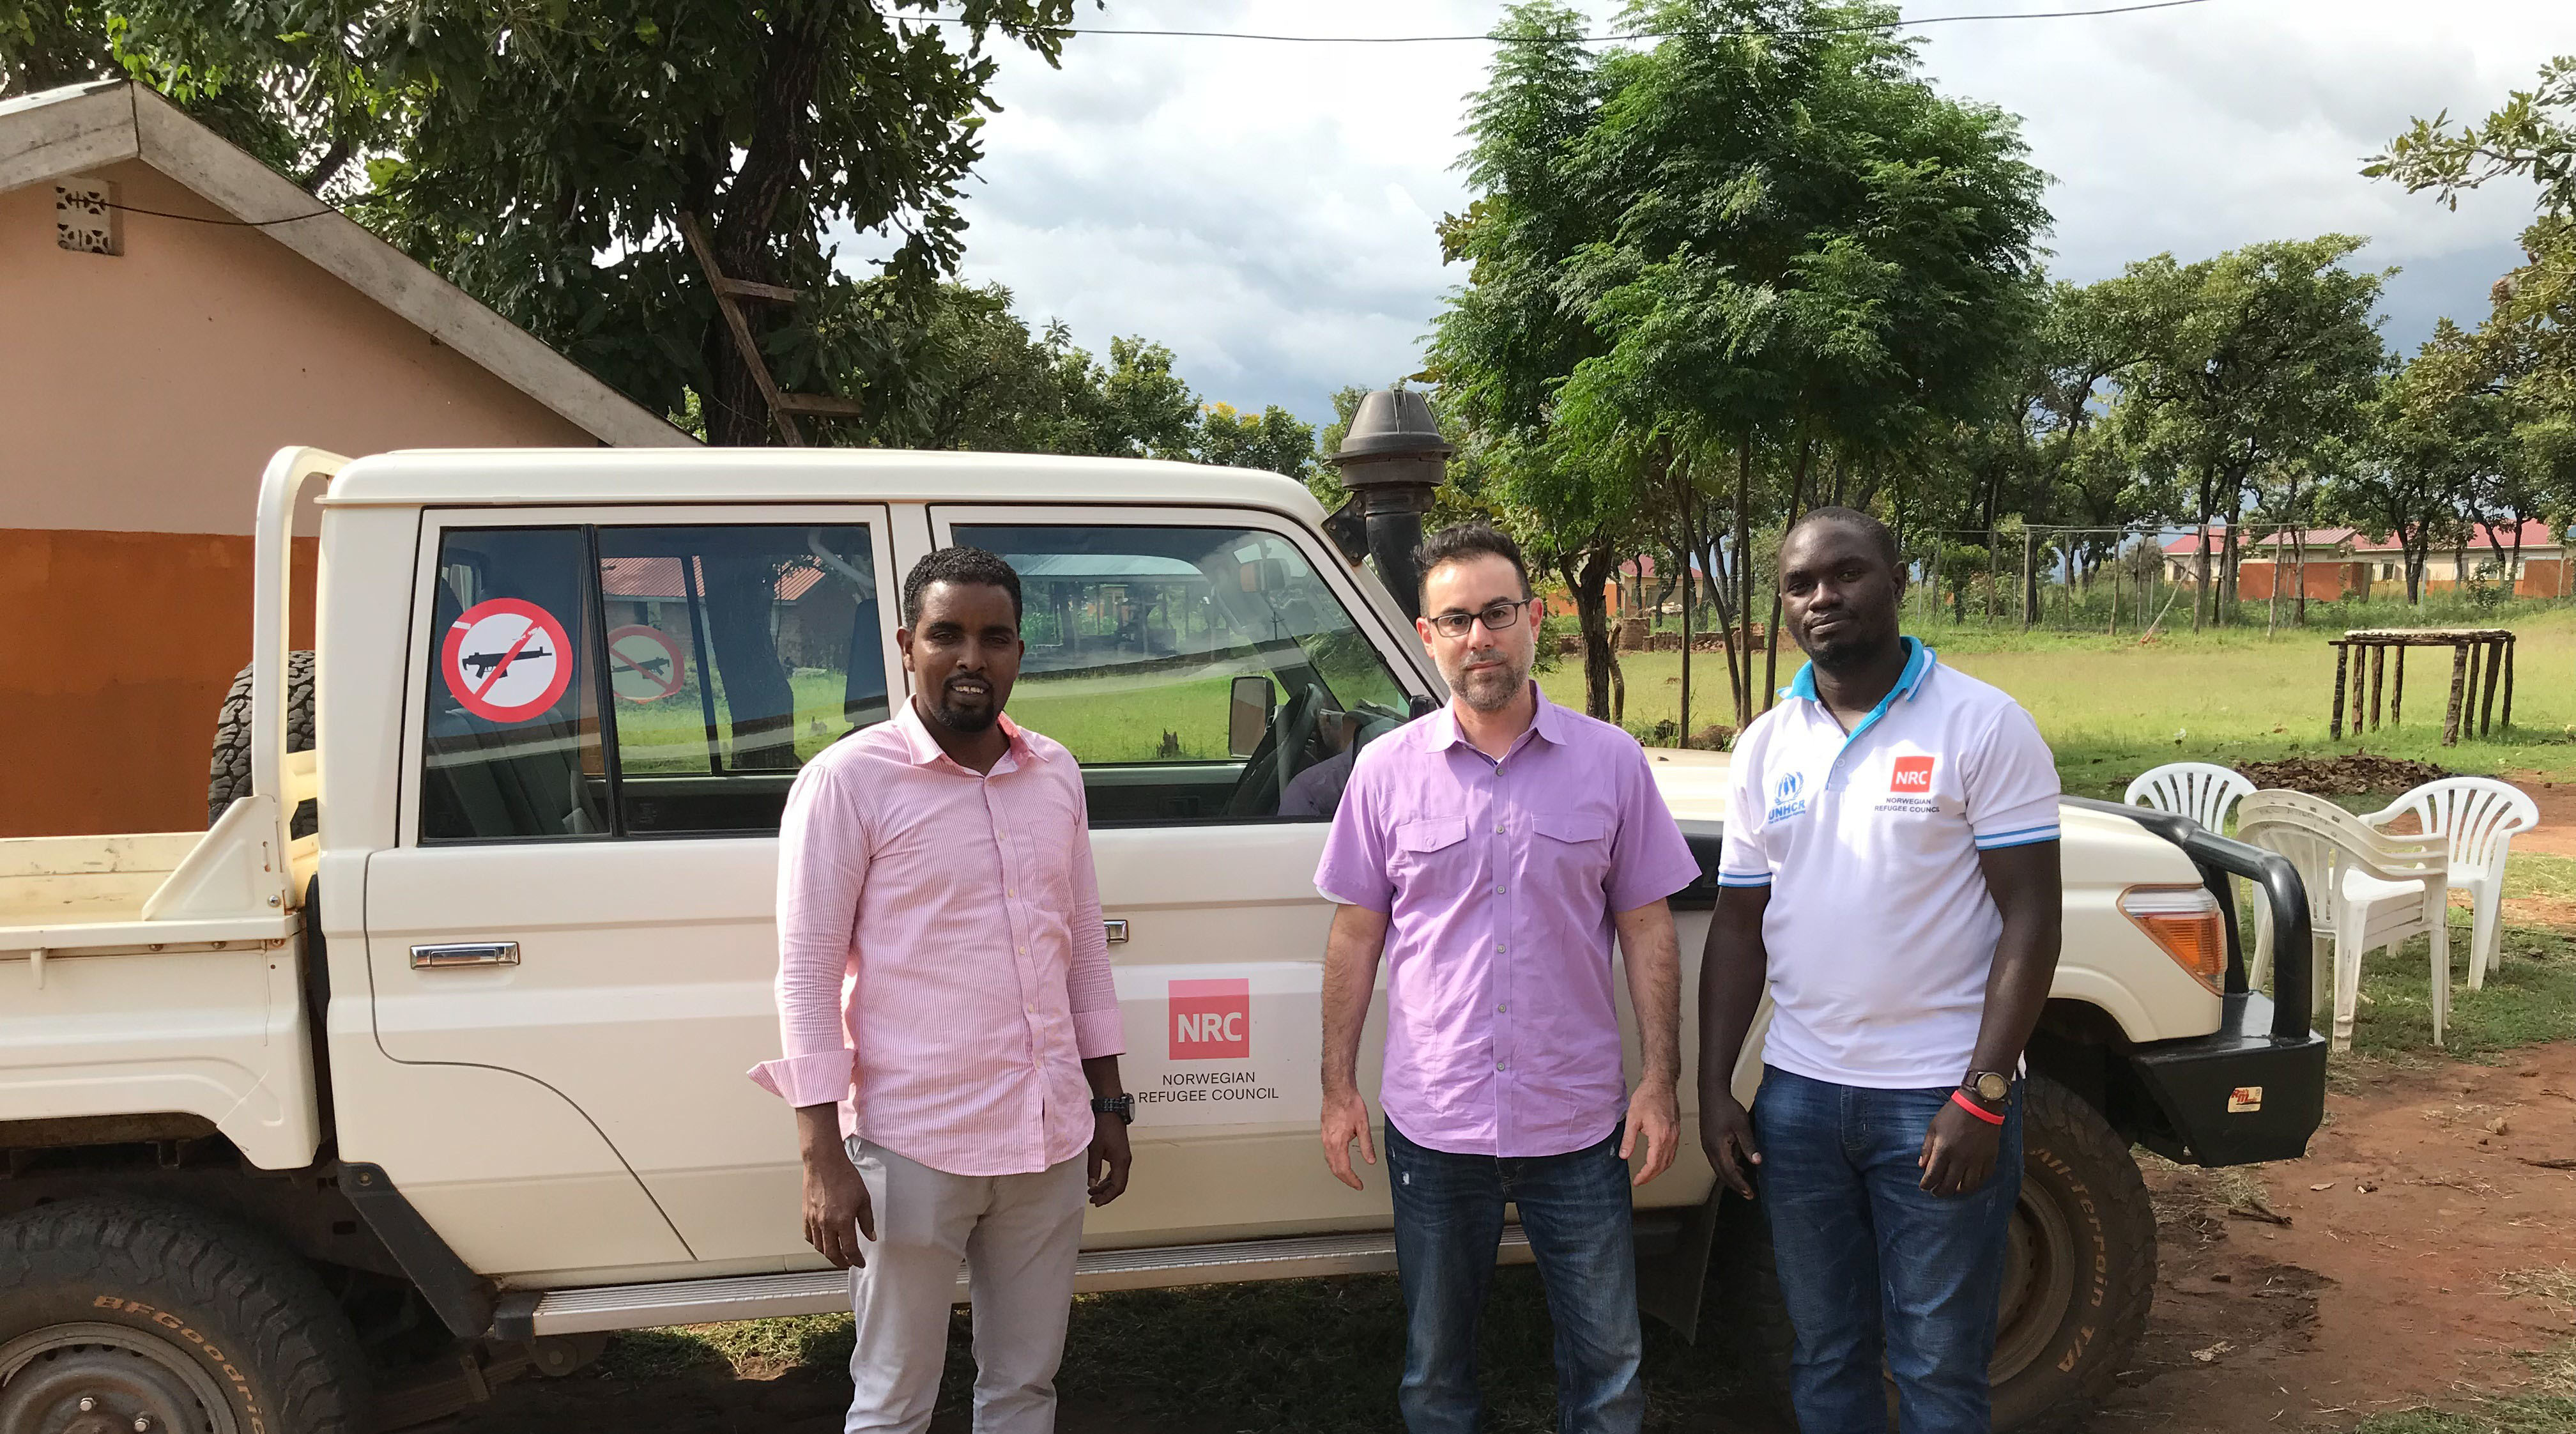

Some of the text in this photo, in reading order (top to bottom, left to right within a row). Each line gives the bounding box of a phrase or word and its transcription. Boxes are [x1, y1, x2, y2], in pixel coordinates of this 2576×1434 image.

[1896, 771, 1928, 785] NRC
[1768, 799, 1805, 821] UNHCR
[1177, 1012, 1242, 1043] NRC
[1163, 1072, 1255, 1086] NORWEGIAN
[1138, 1087, 1279, 1104] REFUGEE COUNCIL
